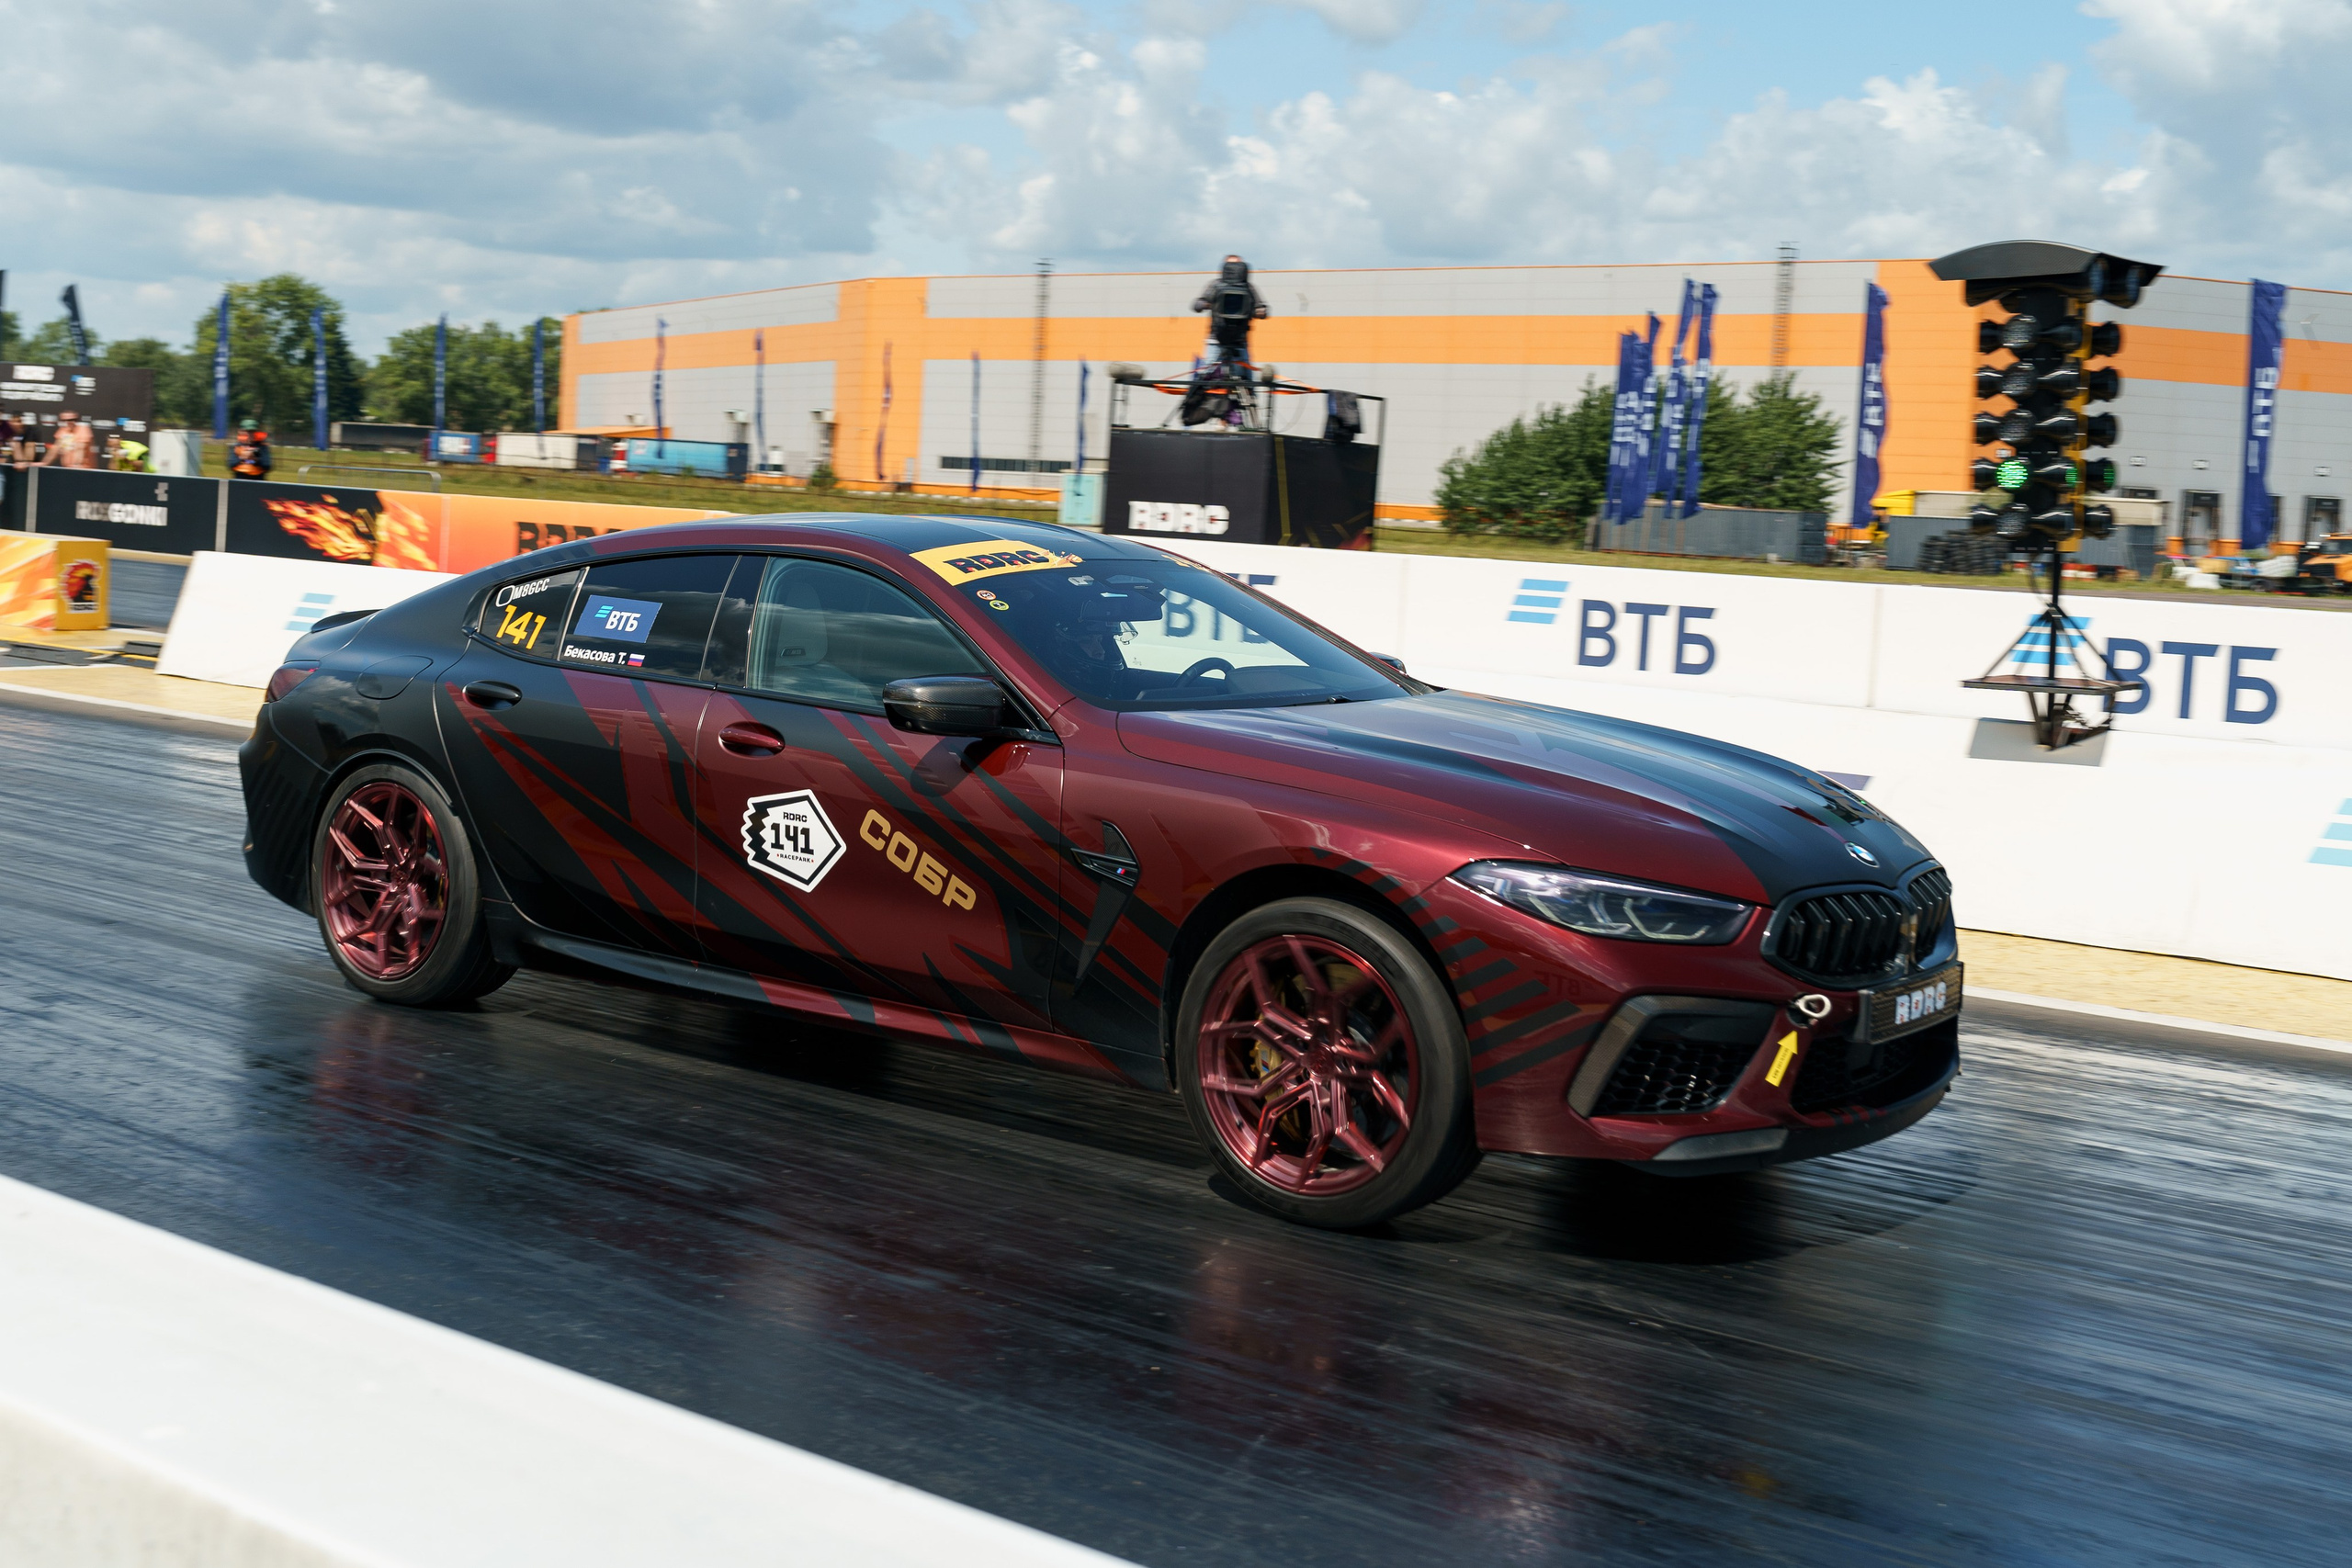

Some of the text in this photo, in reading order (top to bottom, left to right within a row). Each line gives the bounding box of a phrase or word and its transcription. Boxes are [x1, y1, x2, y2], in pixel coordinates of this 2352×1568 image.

[1127, 501, 1230, 536] RDRC
[943, 549, 1051, 575] RDRC
[496, 604, 547, 650] 141
[605, 611, 641, 633] ВТБ
[1576, 598, 1717, 676] ВТБ
[563, 645, 628, 665] Бекасова Т.
[2101, 637, 2280, 725] ВТБ
[783, 811, 808, 823] RDRC
[770, 822, 815, 856] 141
[779, 853, 811, 863] RACEPARK
[859, 808, 977, 911] СОБР
[1894, 980, 1947, 1026] RDRC
